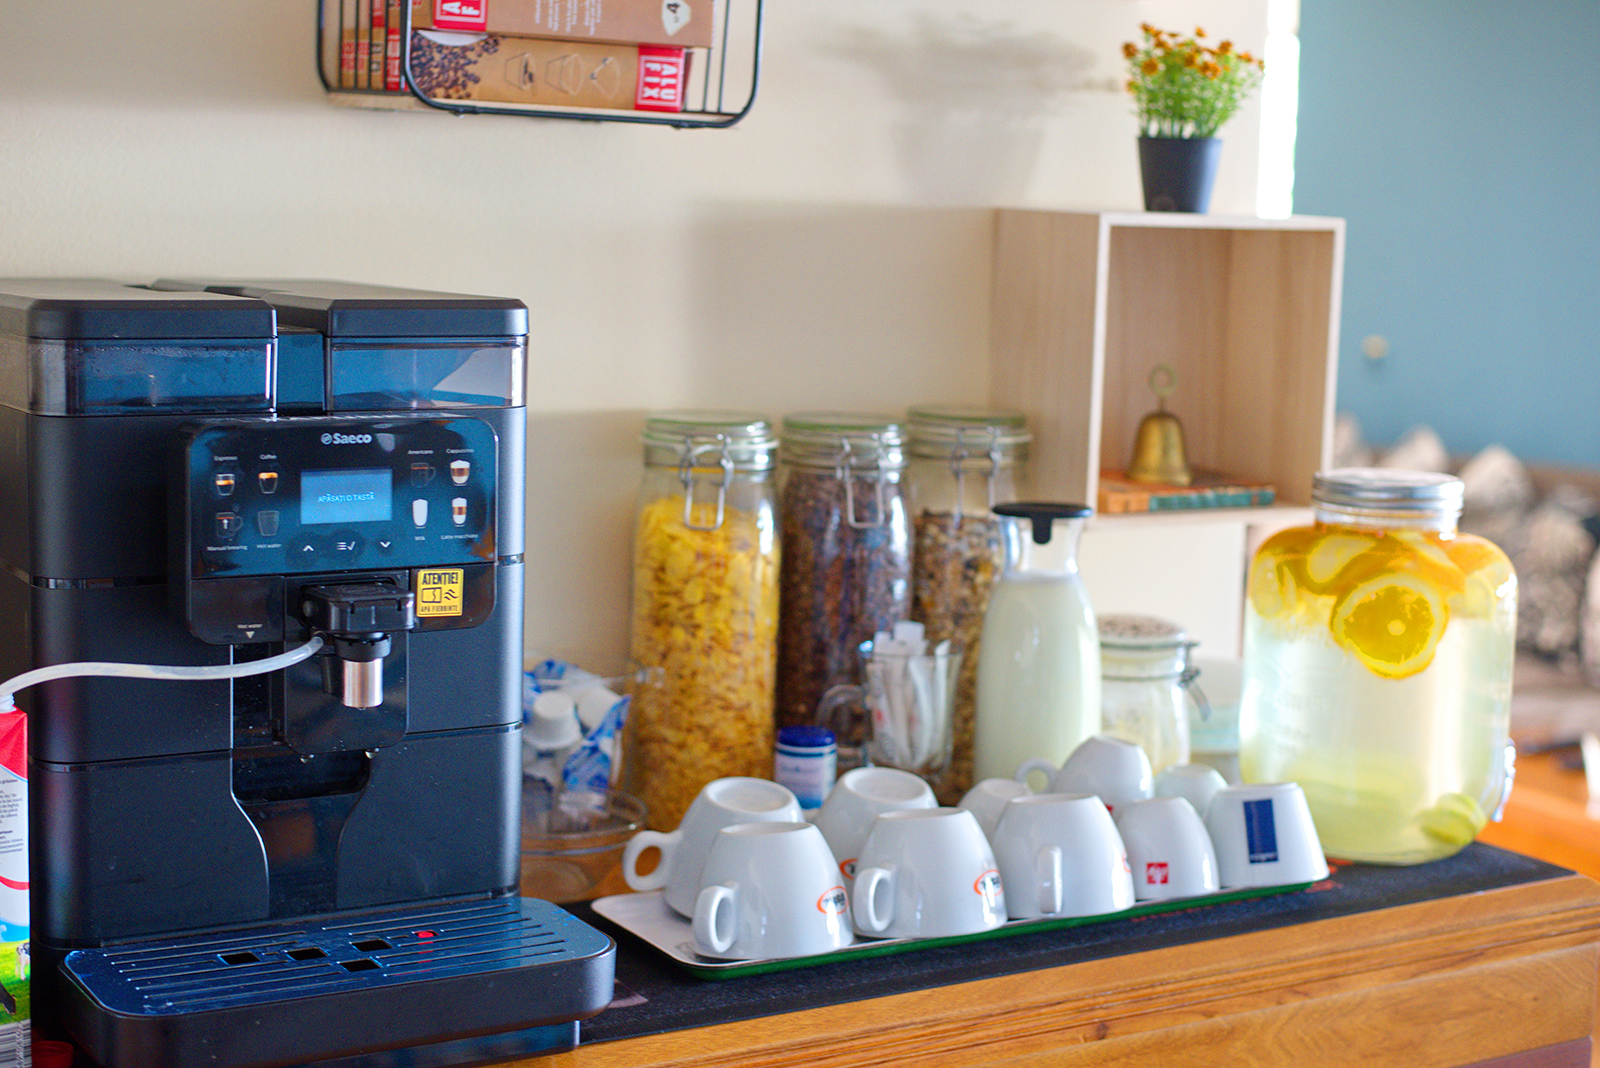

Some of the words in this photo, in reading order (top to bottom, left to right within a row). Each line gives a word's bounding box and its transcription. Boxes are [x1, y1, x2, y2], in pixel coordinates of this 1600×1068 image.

[643, 62, 661, 98] FIX
[660, 63, 678, 100] ALU
[333, 432, 373, 445] Saeco
[346, 494, 353, 502] O
